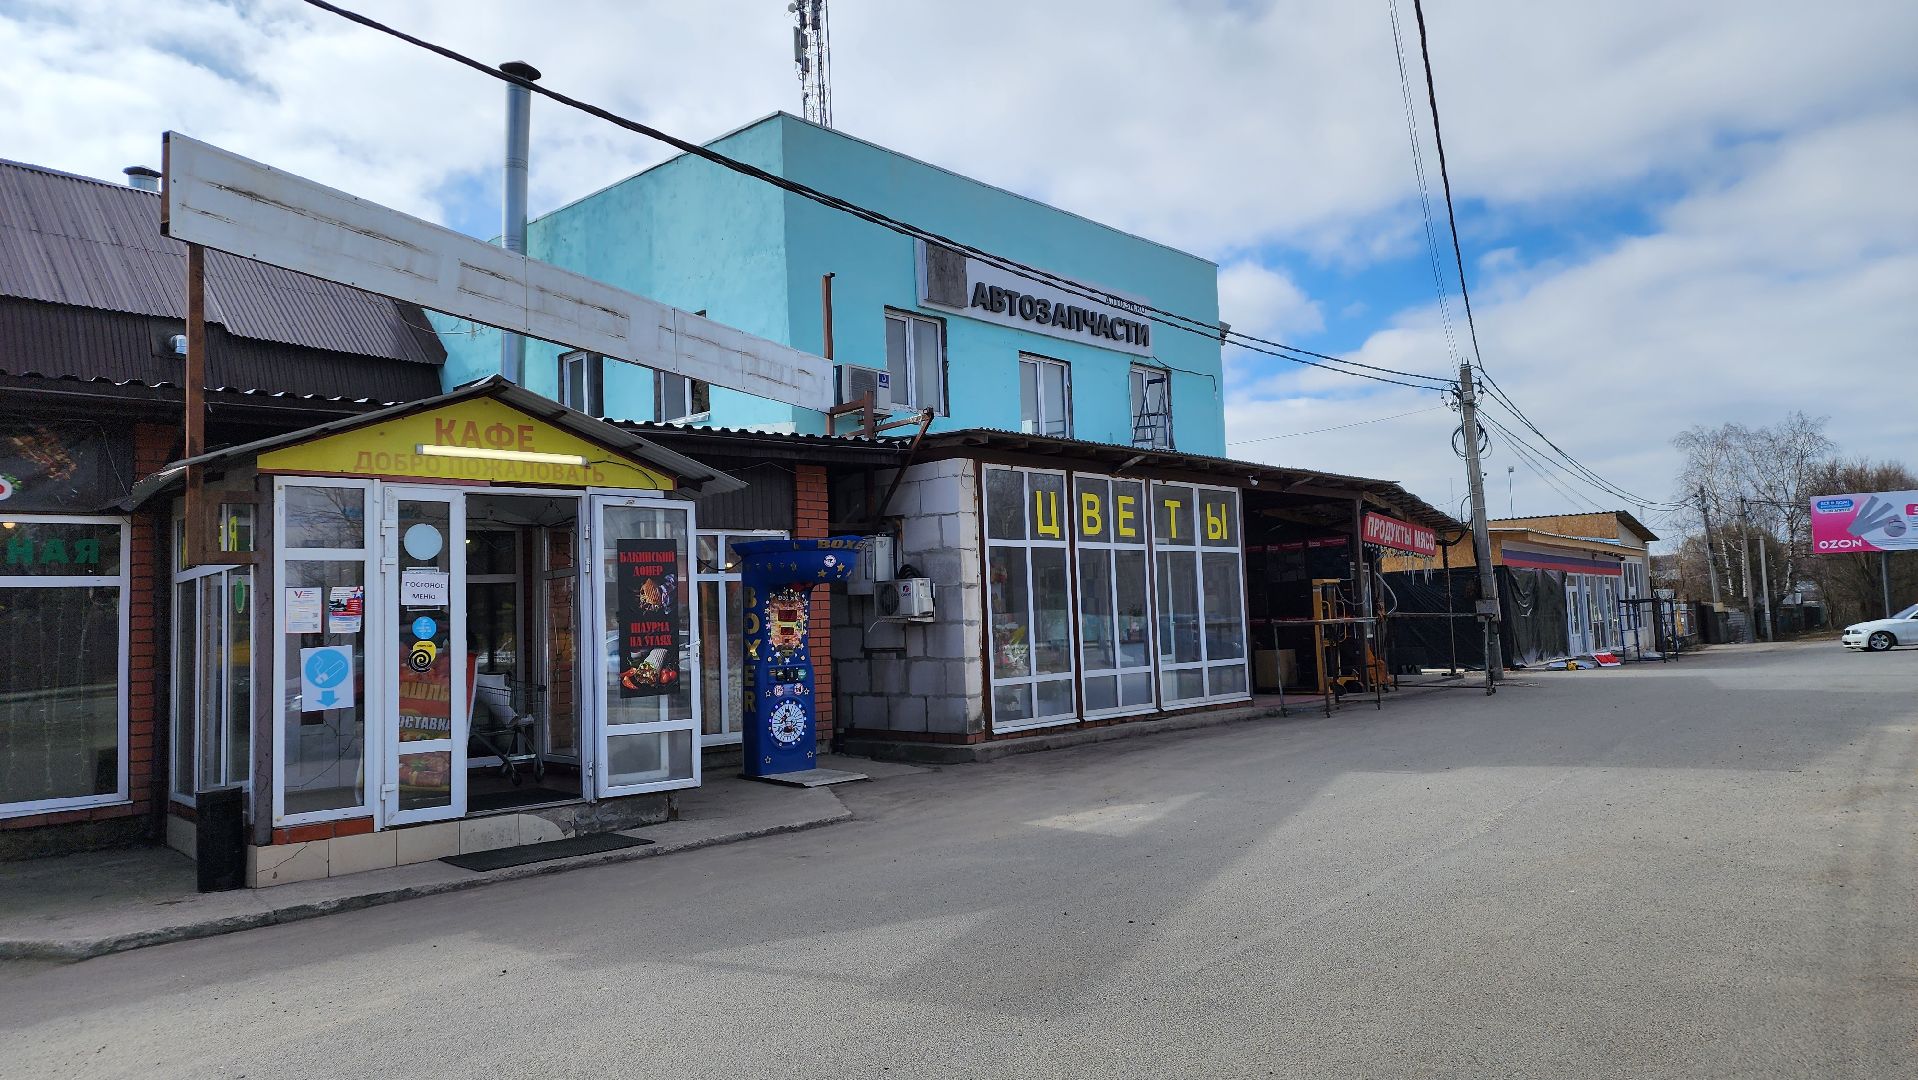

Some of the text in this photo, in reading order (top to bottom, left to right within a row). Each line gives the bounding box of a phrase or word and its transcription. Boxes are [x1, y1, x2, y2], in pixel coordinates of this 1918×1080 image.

[971, 282, 1149, 346] АВТОЗАПЧАСТИ
[435, 417, 535, 452] КАФЕ
[353, 451, 605, 482] ДОБРО ПОЖАЛОВАТЬ
[1036, 490, 1227, 540] ЦВЕТЫ
[1367, 516, 1435, 551] ПРОДУКТЫ МЯСО
[1819, 539, 1862, 550] OZON
[620, 551, 675, 563] БАКИНСКИЙ
[633, 565, 663, 577] ДОНЕР
[630, 636, 641, 647] НА
[631, 622, 670, 634] ШАУРМА
[743, 586, 762, 713] BOXER
